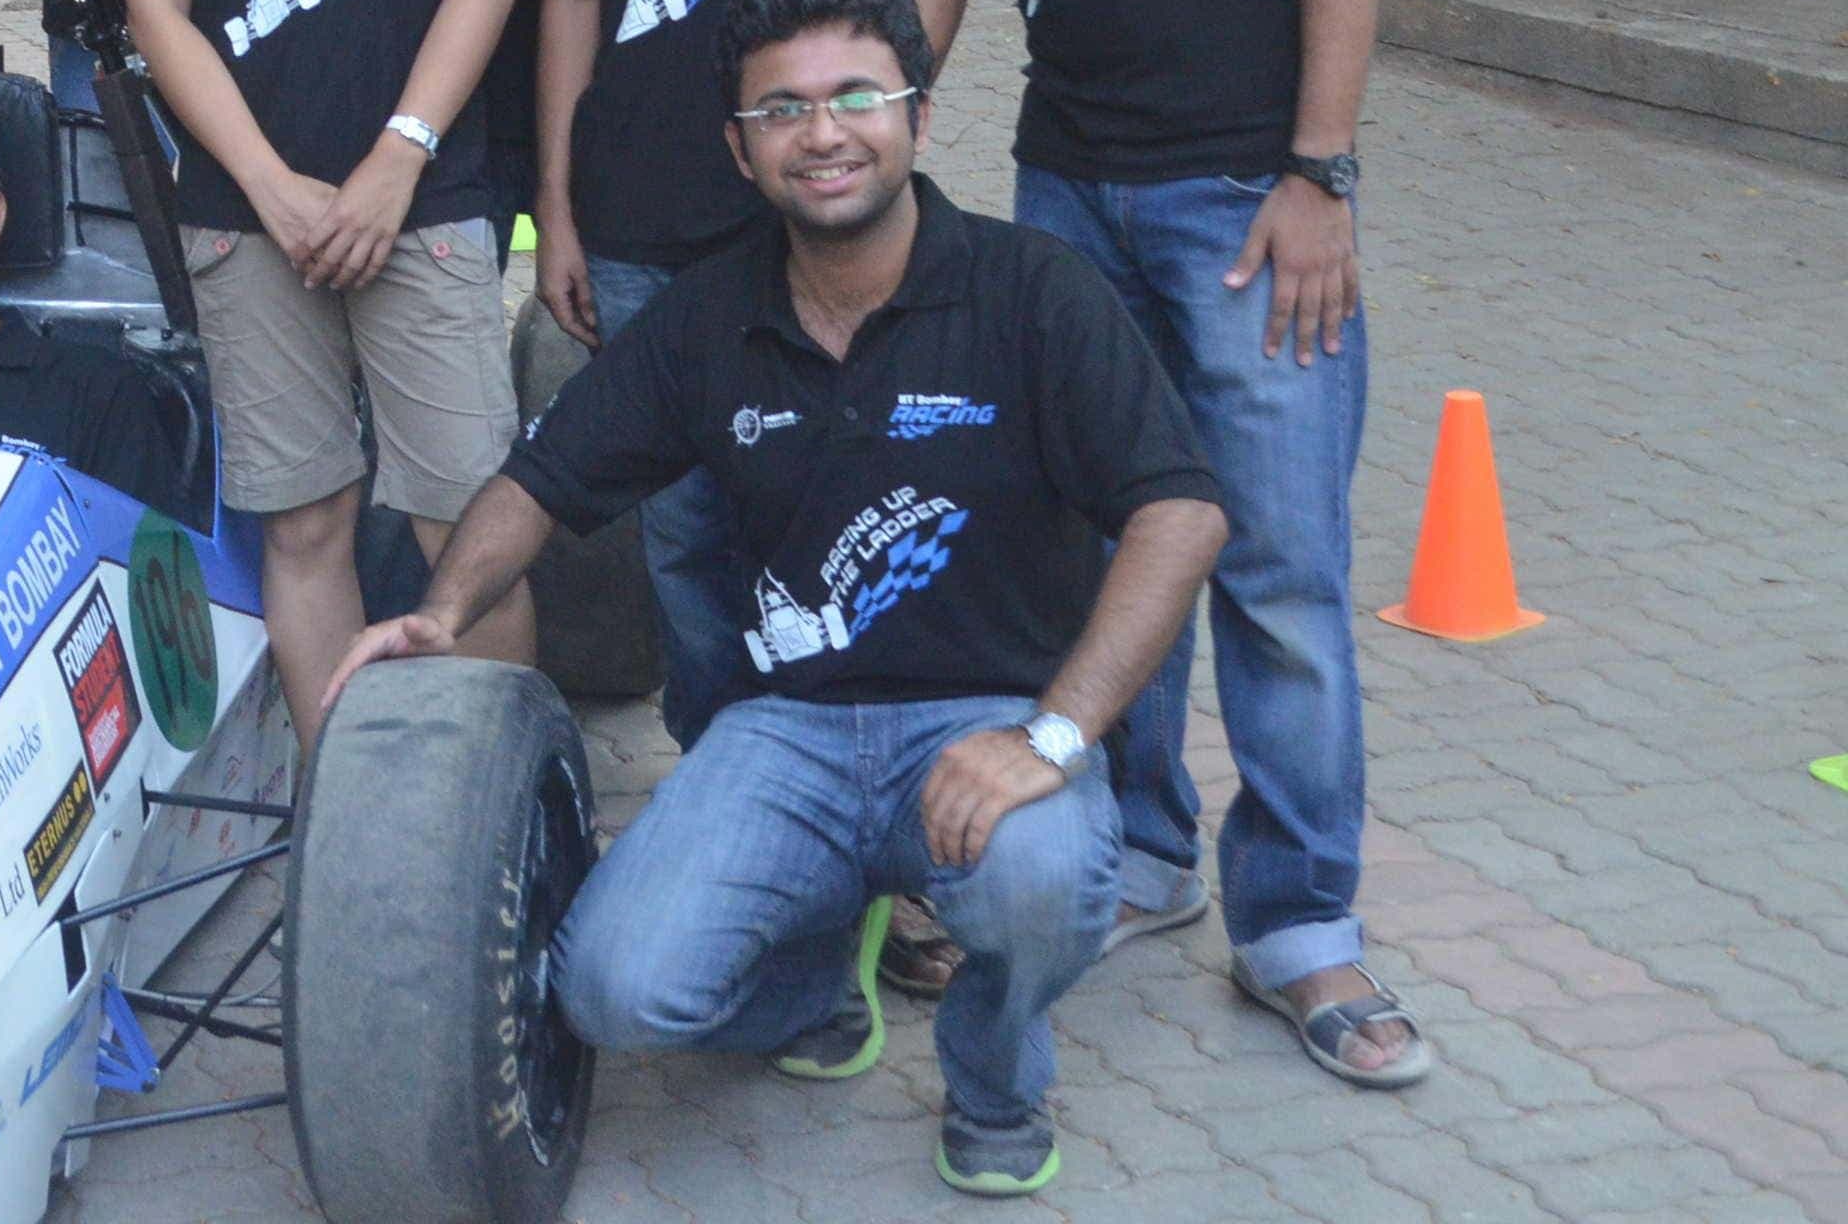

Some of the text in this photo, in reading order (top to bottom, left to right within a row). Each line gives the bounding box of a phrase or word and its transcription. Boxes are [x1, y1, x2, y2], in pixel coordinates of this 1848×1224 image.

[820, 486, 917, 587] RACING UP
[830, 496, 957, 608] THE LADDER
[59, 594, 113, 686] FORMULA
[73, 628, 123, 726] STUDENT
[26, 795, 75, 877] ETERNUS
[0, 862, 26, 917] Ltd
